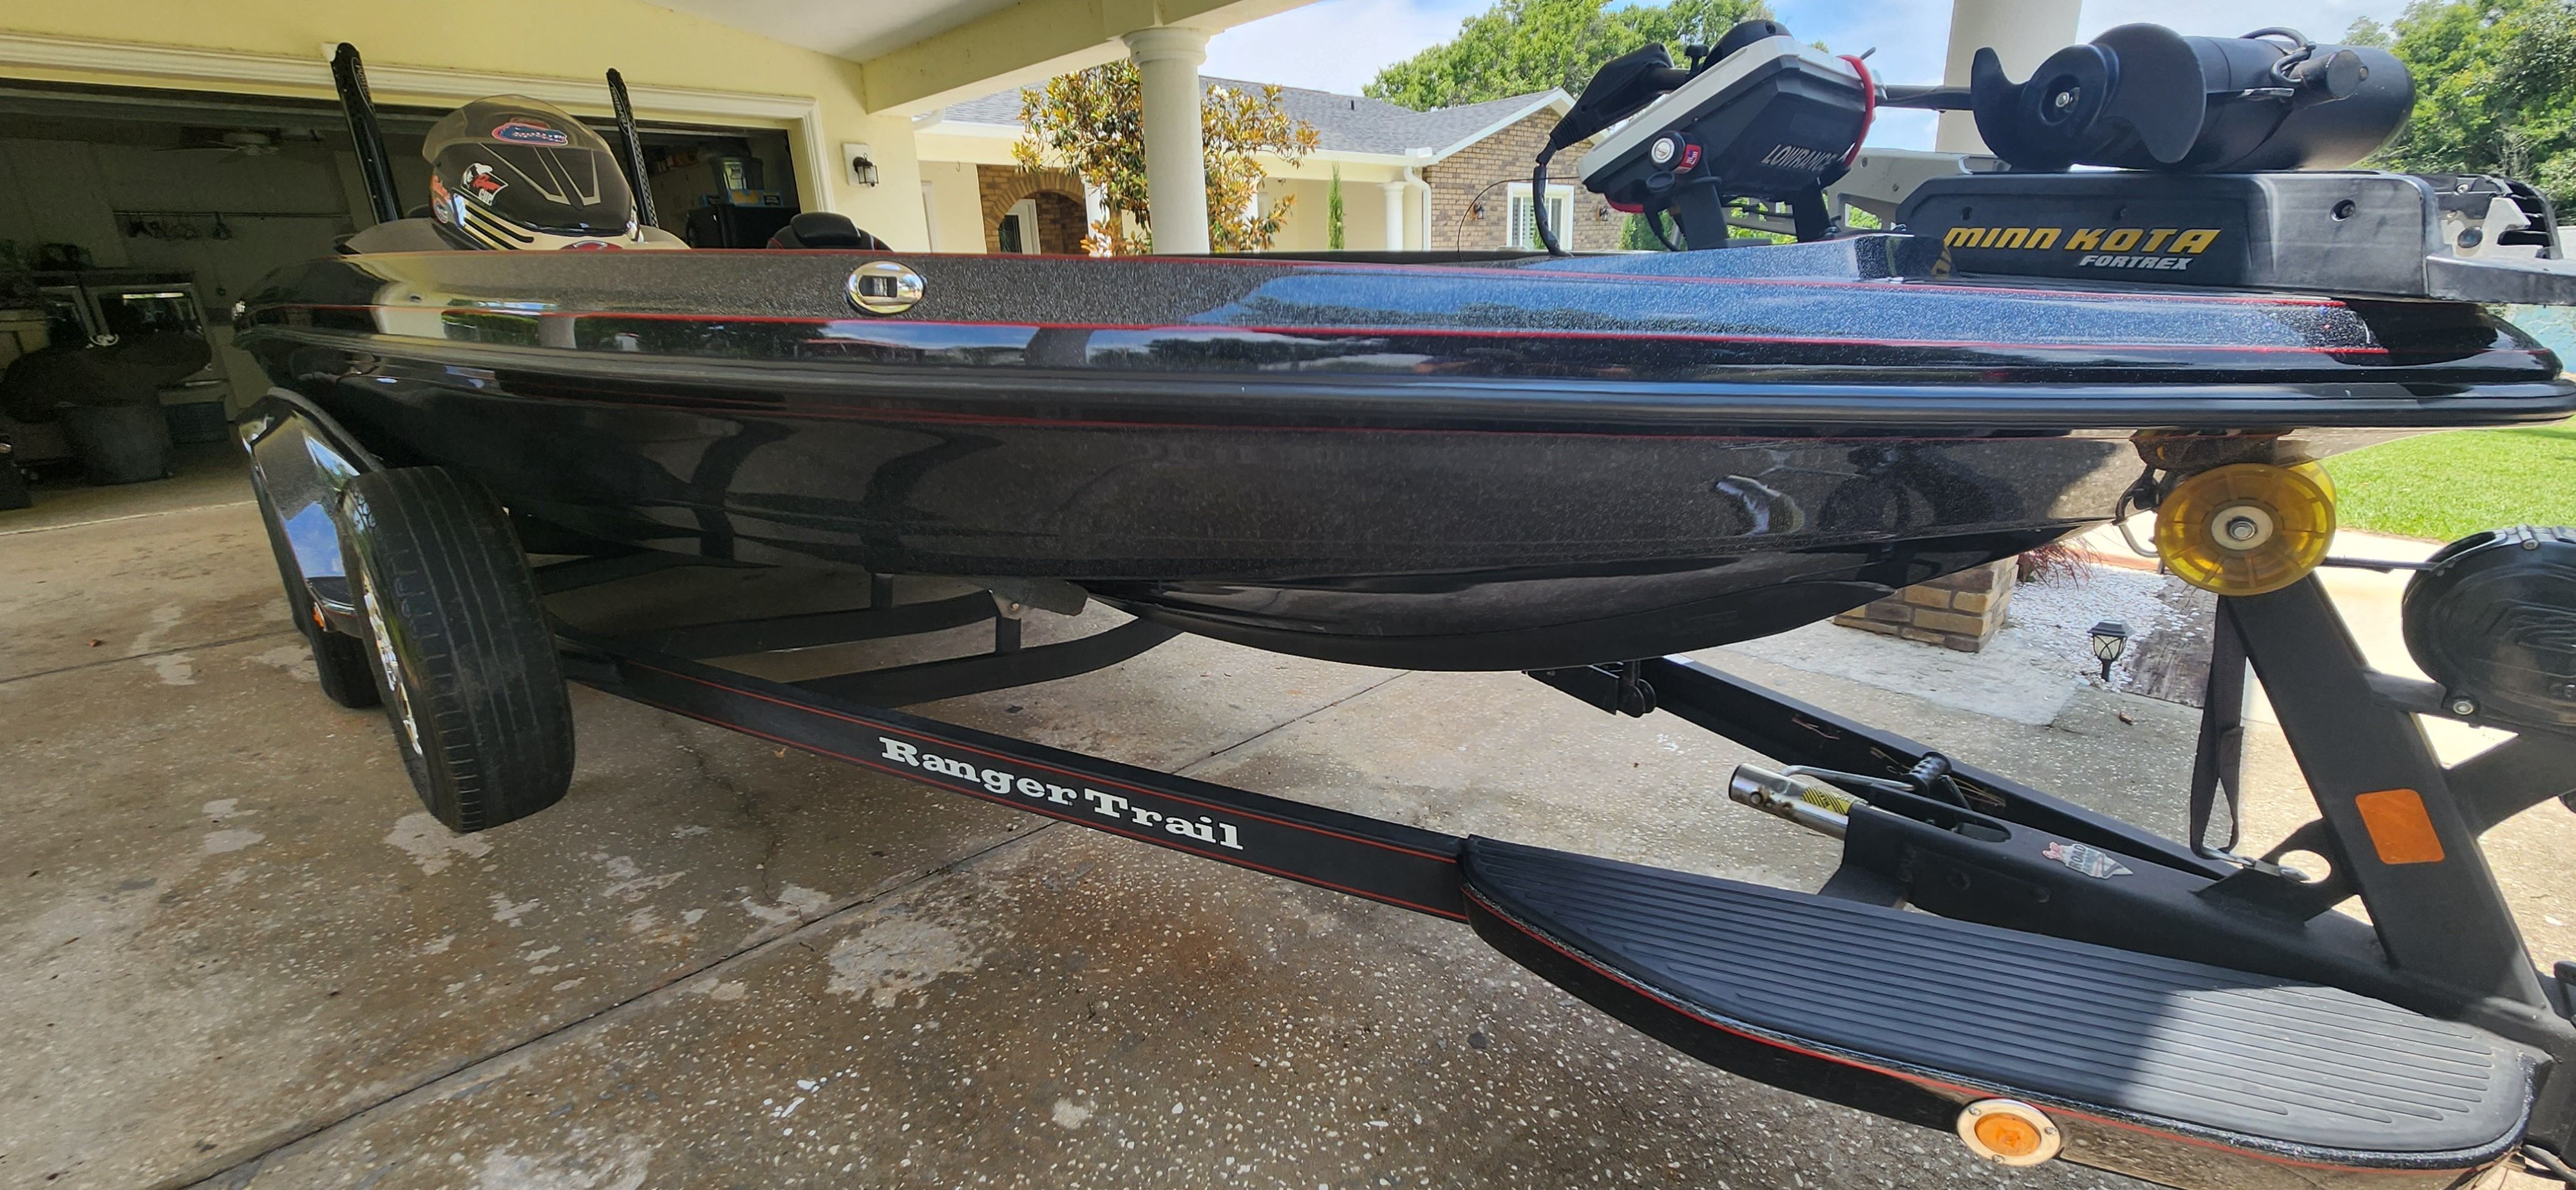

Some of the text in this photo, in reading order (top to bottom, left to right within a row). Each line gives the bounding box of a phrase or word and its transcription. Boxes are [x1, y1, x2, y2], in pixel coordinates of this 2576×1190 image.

[1761, 144, 1837, 171] LOWRANCE
[1944, 227, 2222, 254] MINN KOTA
[2078, 255, 2193, 270] FORTREX
[878, 736, 1244, 851] Ranger Trail
[2069, 844, 2087, 870] ROAD
